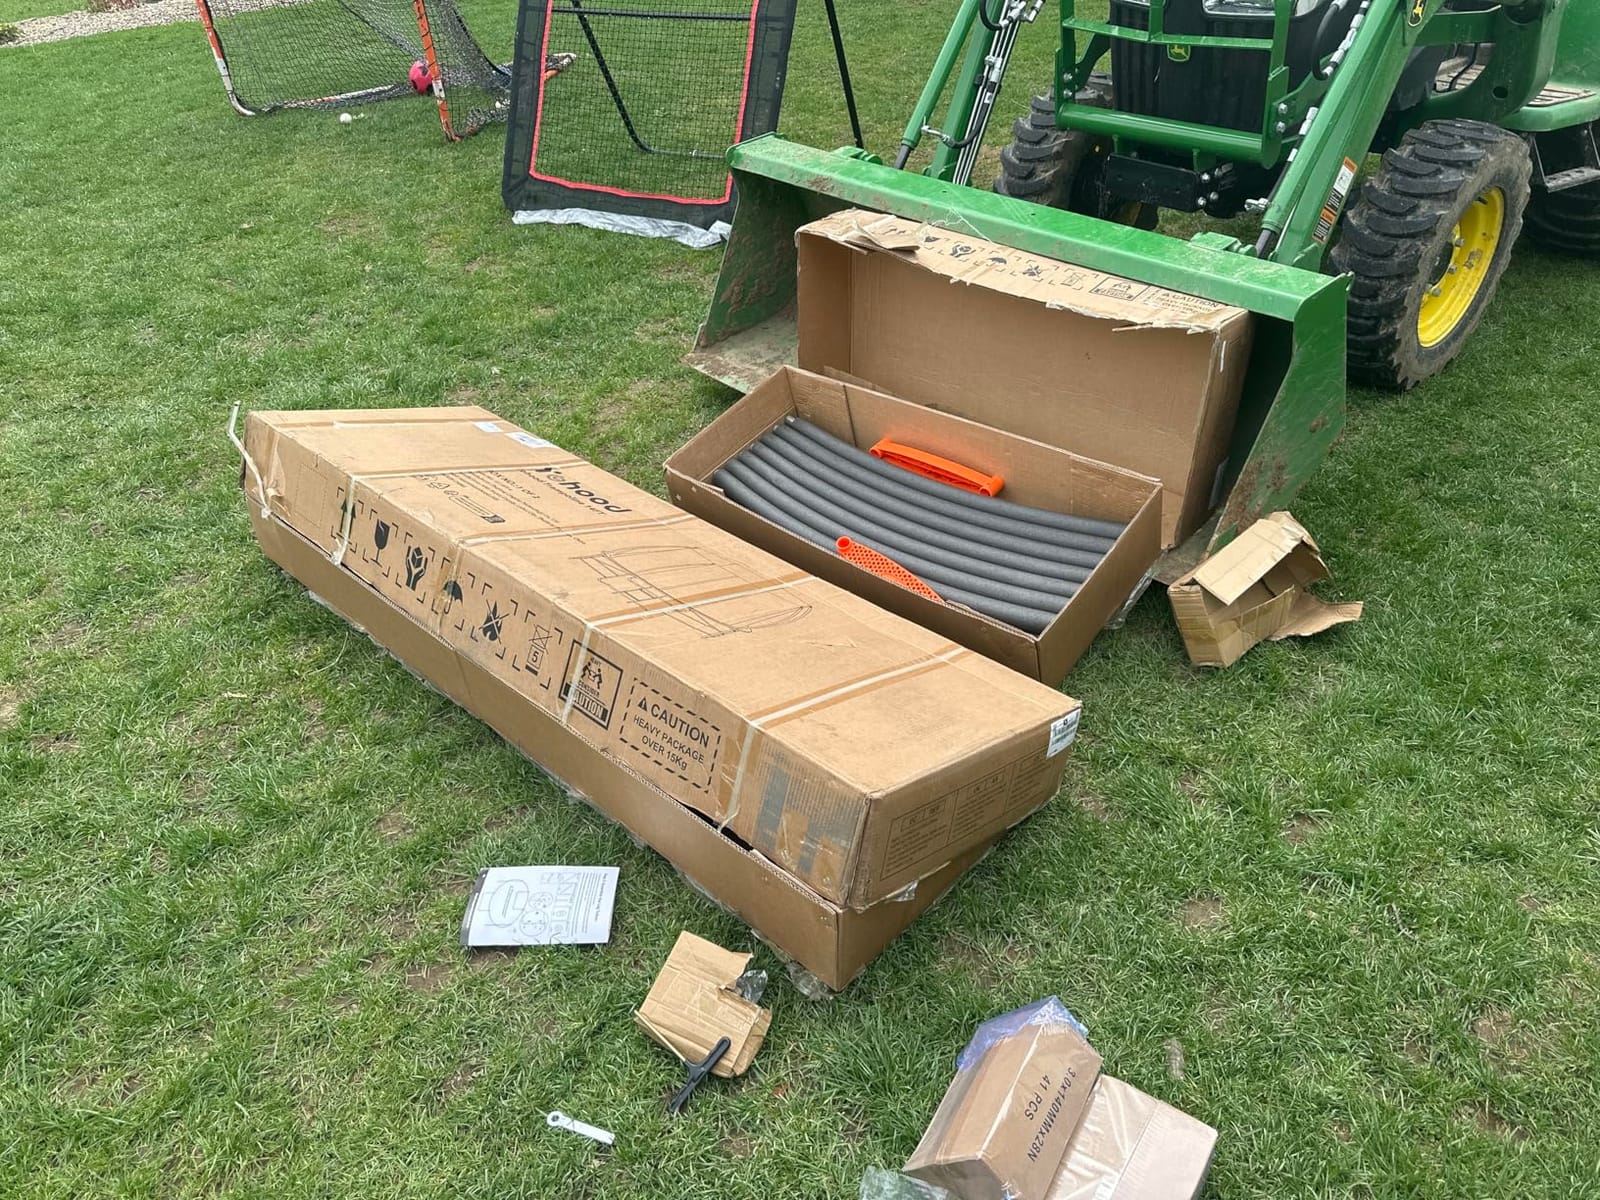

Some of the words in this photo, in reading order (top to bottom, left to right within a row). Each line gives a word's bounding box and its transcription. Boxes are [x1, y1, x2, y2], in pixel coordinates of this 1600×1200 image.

[571, 689, 603, 719] AUTION
[633, 714, 661, 738] HEAVY
[661, 734, 705, 764] PACKAGE
[650, 703, 710, 748] CAUTION
[641, 735, 665, 756] OVER
[666, 751, 688, 771] 15Kg
[1039, 1074, 1052, 1092] 41
[1024, 1091, 1044, 1121] PCS
